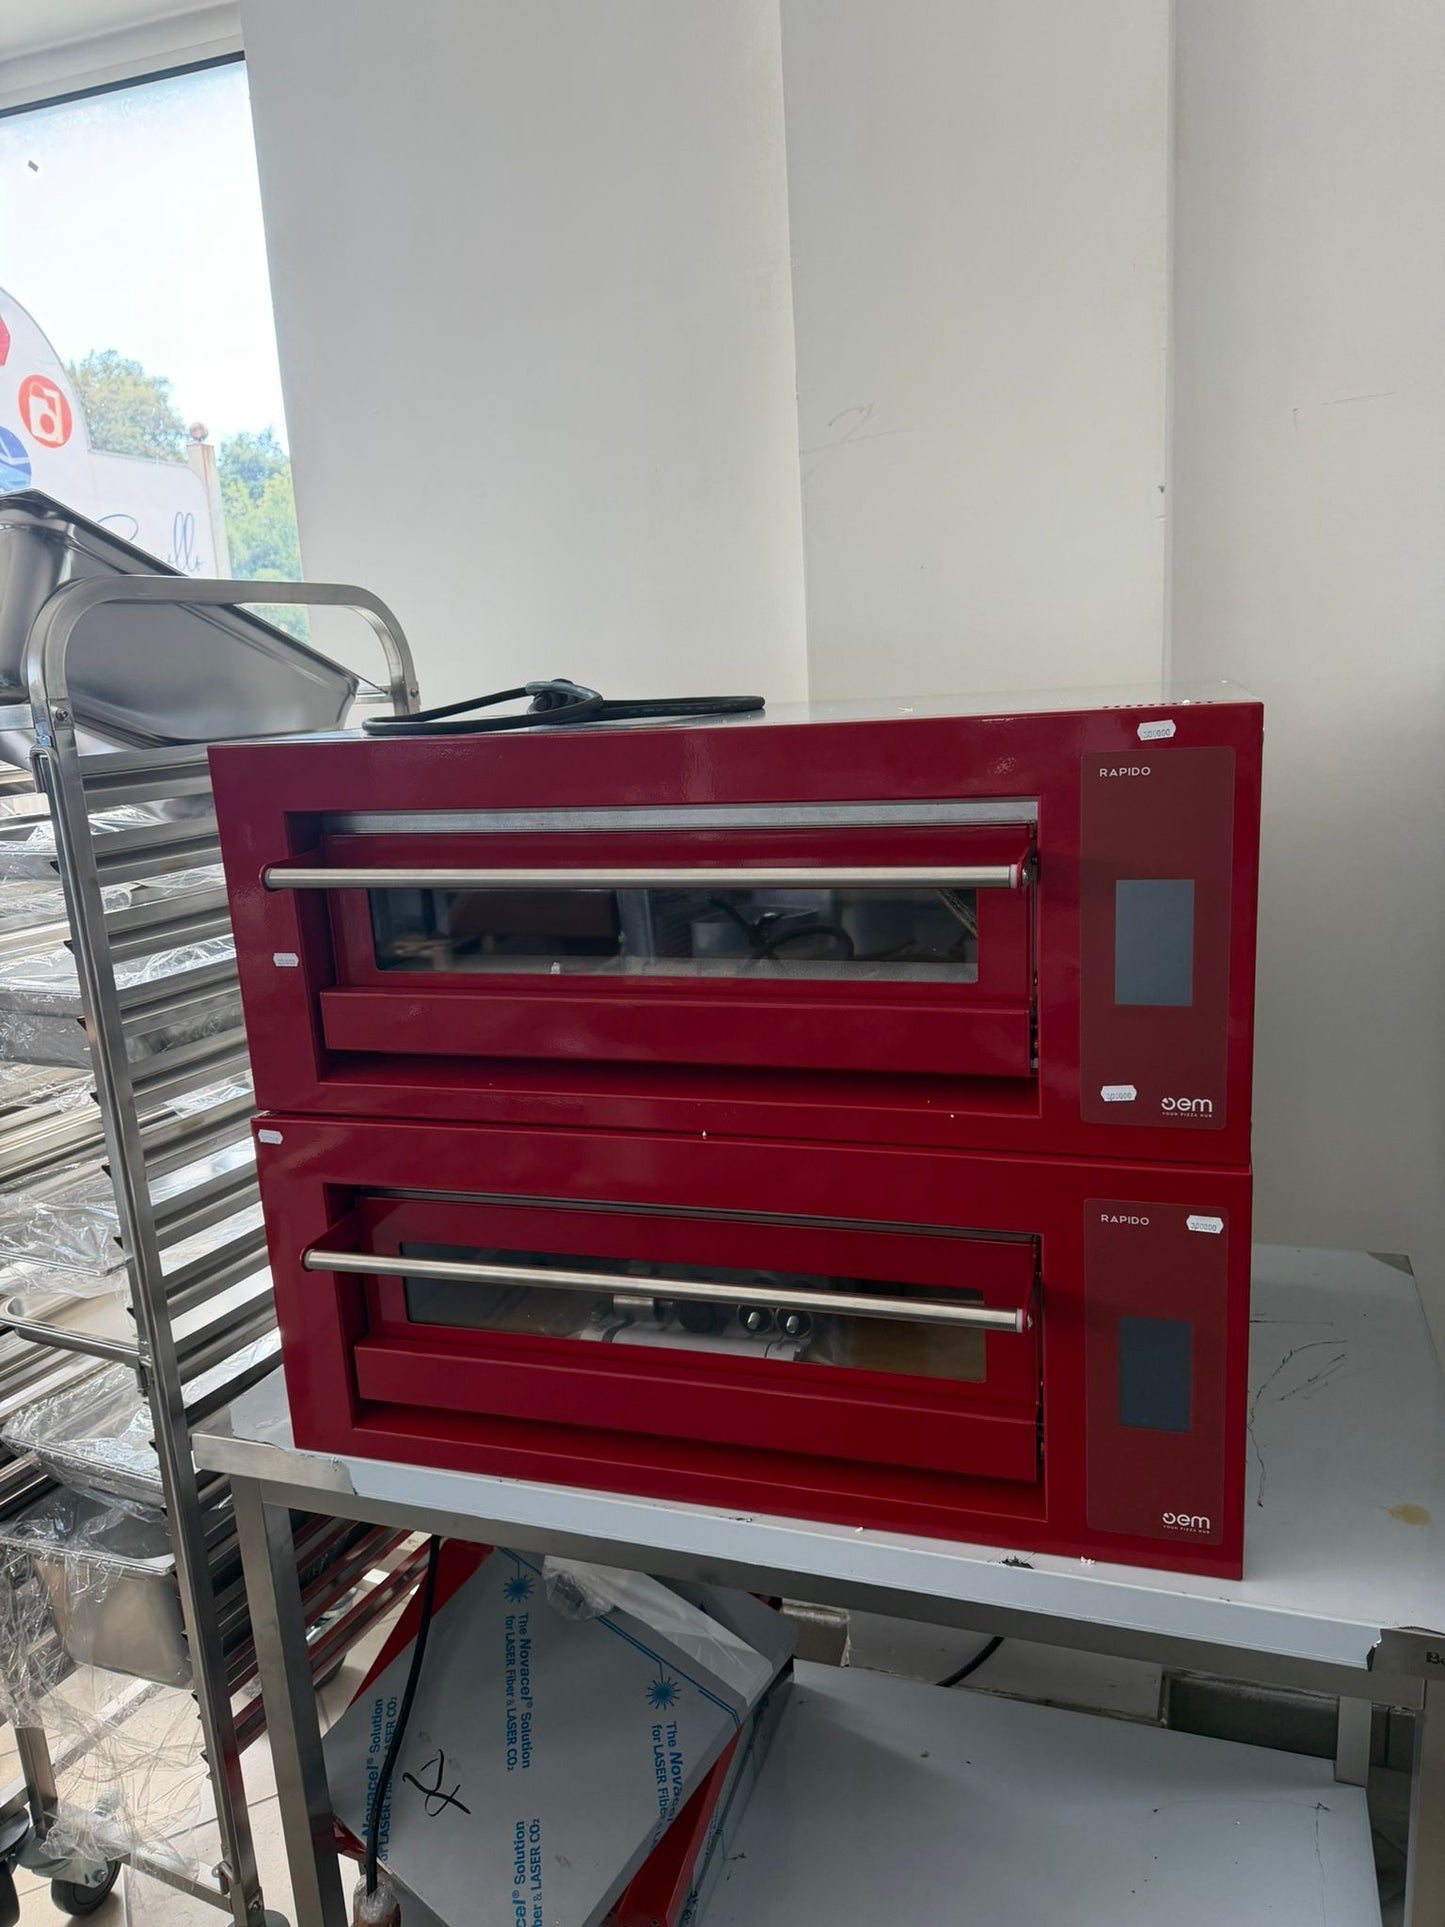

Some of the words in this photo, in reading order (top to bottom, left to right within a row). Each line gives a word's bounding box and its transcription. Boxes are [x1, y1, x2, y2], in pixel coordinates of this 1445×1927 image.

[1099, 766, 1151, 778] RAPIDO
[1100, 1213, 1151, 1226] RAPIDO
[505, 1615, 516, 1631] for
[518, 1612, 529, 1636] The
[505, 1632, 516, 1667] LASER
[505, 1669, 517, 1697] Fiber
[369, 1698, 384, 1754] Solution
[506, 1708, 518, 1746] LASER
[520, 1711, 533, 1769] Solution
[651, 1723, 663, 1743] for
[666, 1721, 678, 1748] The
[653, 1744, 668, 1785] LASER
[378, 1810, 391, 1846] LASER
[514, 1820, 526, 1886] Solution
[529, 1845, 542, 1892] LASER
[532, 1892, 543, 1902] &
